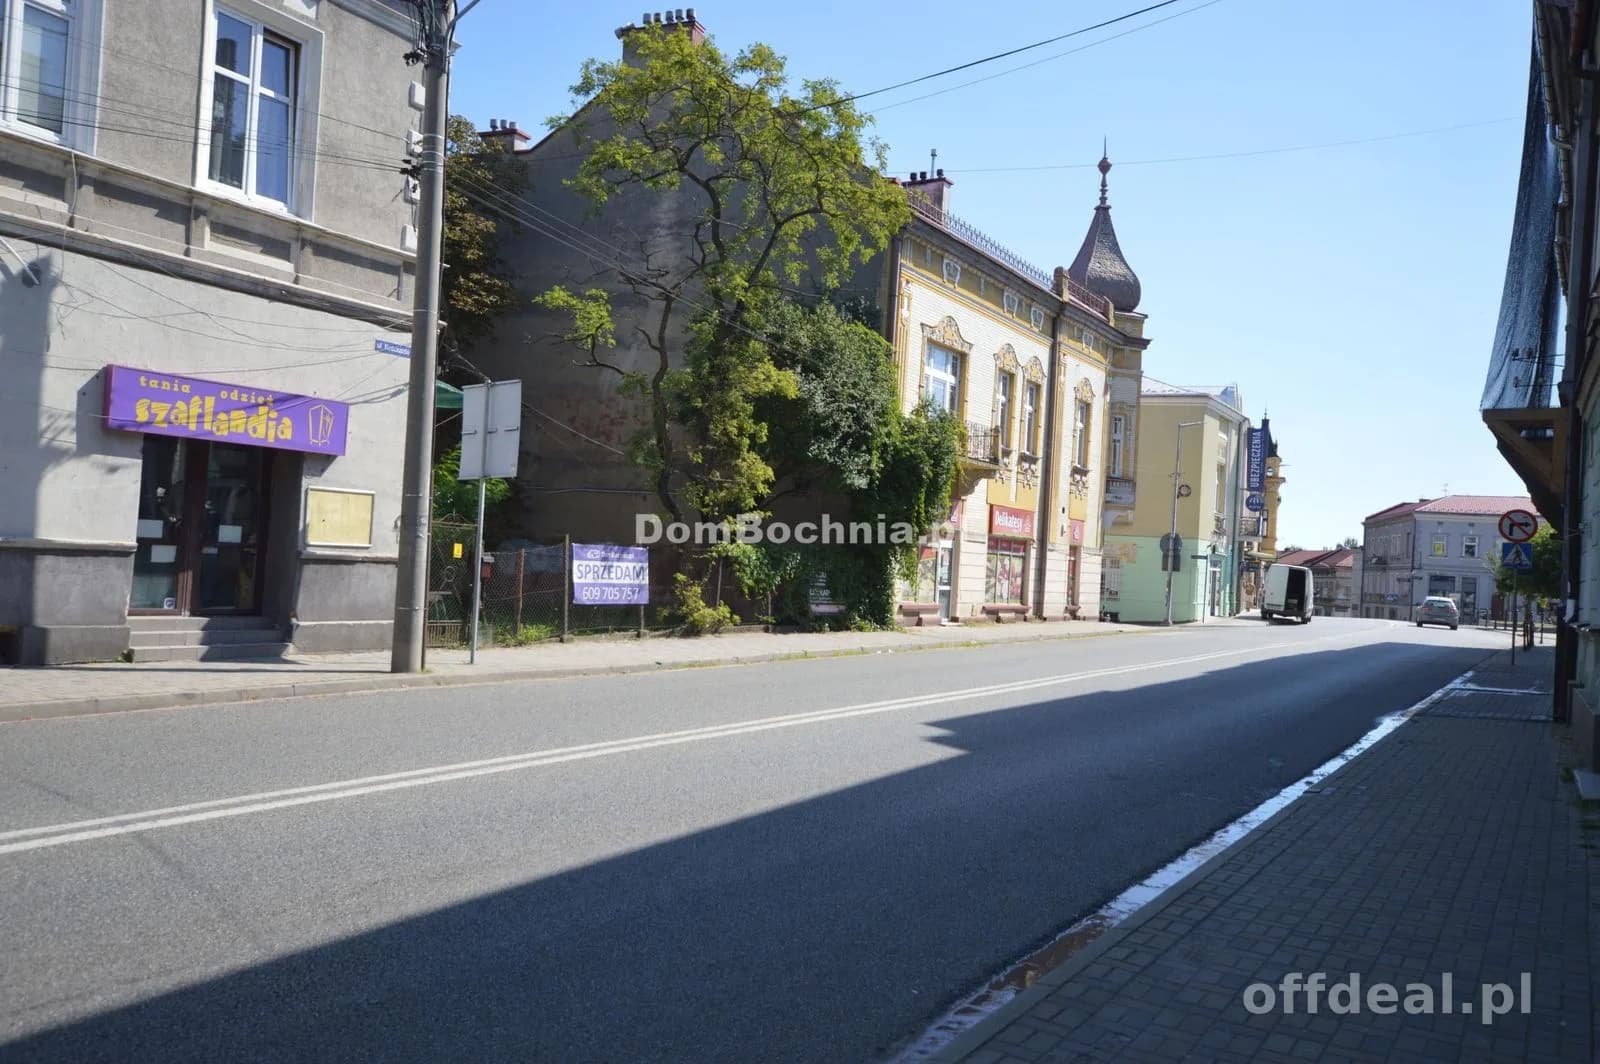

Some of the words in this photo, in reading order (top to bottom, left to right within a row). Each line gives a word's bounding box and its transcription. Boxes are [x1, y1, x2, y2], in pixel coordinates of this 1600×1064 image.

[139, 375, 191, 394] tania
[135, 395, 293, 443] szaflandia
[1250, 431, 1262, 488] UBEZPIECZENIA
[577, 563, 645, 581] SPRZEDAM
[583, 586, 600, 600] 609
[602, 587, 620, 600] 705
[622, 587, 640, 600] 757
